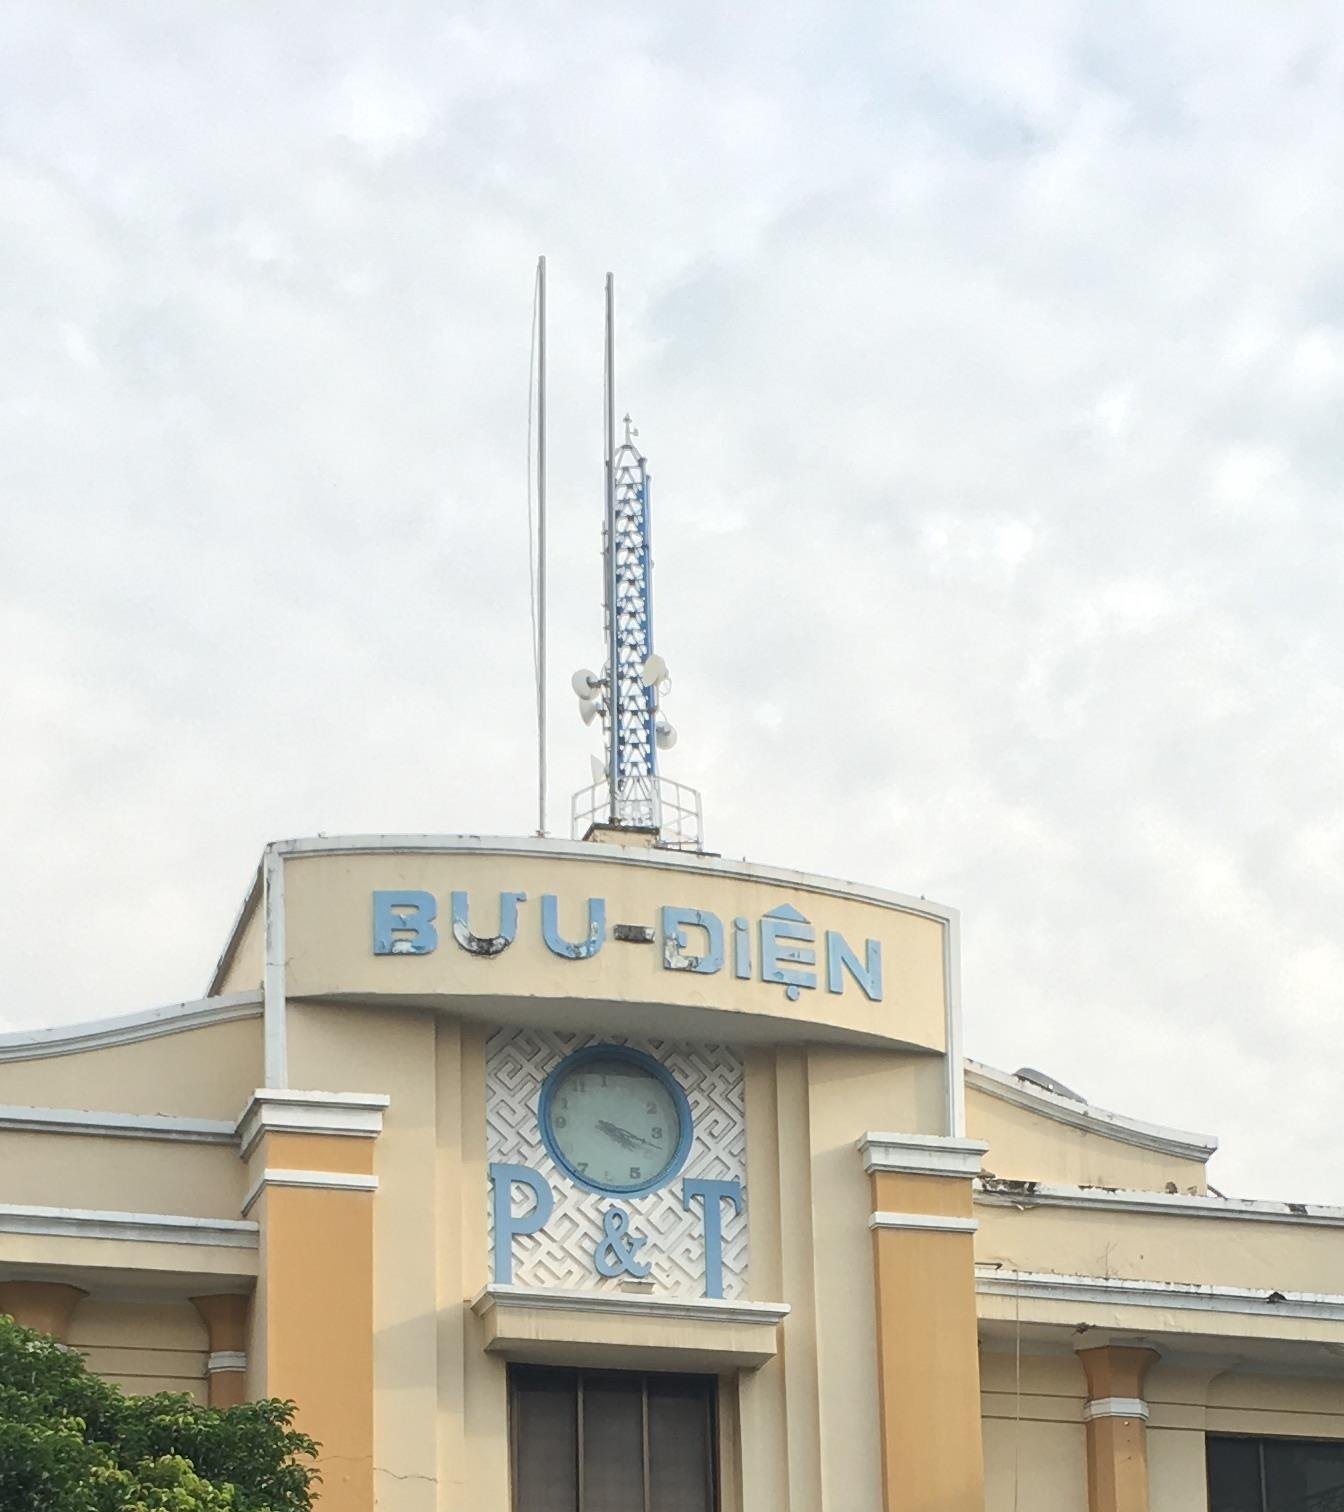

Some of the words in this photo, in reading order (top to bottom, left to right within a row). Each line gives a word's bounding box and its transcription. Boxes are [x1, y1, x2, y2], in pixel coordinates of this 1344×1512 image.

[651, 1127, 662, 1139] 3
[629, 1167, 641, 1179] 5
[489, 1162, 554, 1284] P
[594, 1206, 653, 1279] &
[682, 1178, 743, 1300] T
